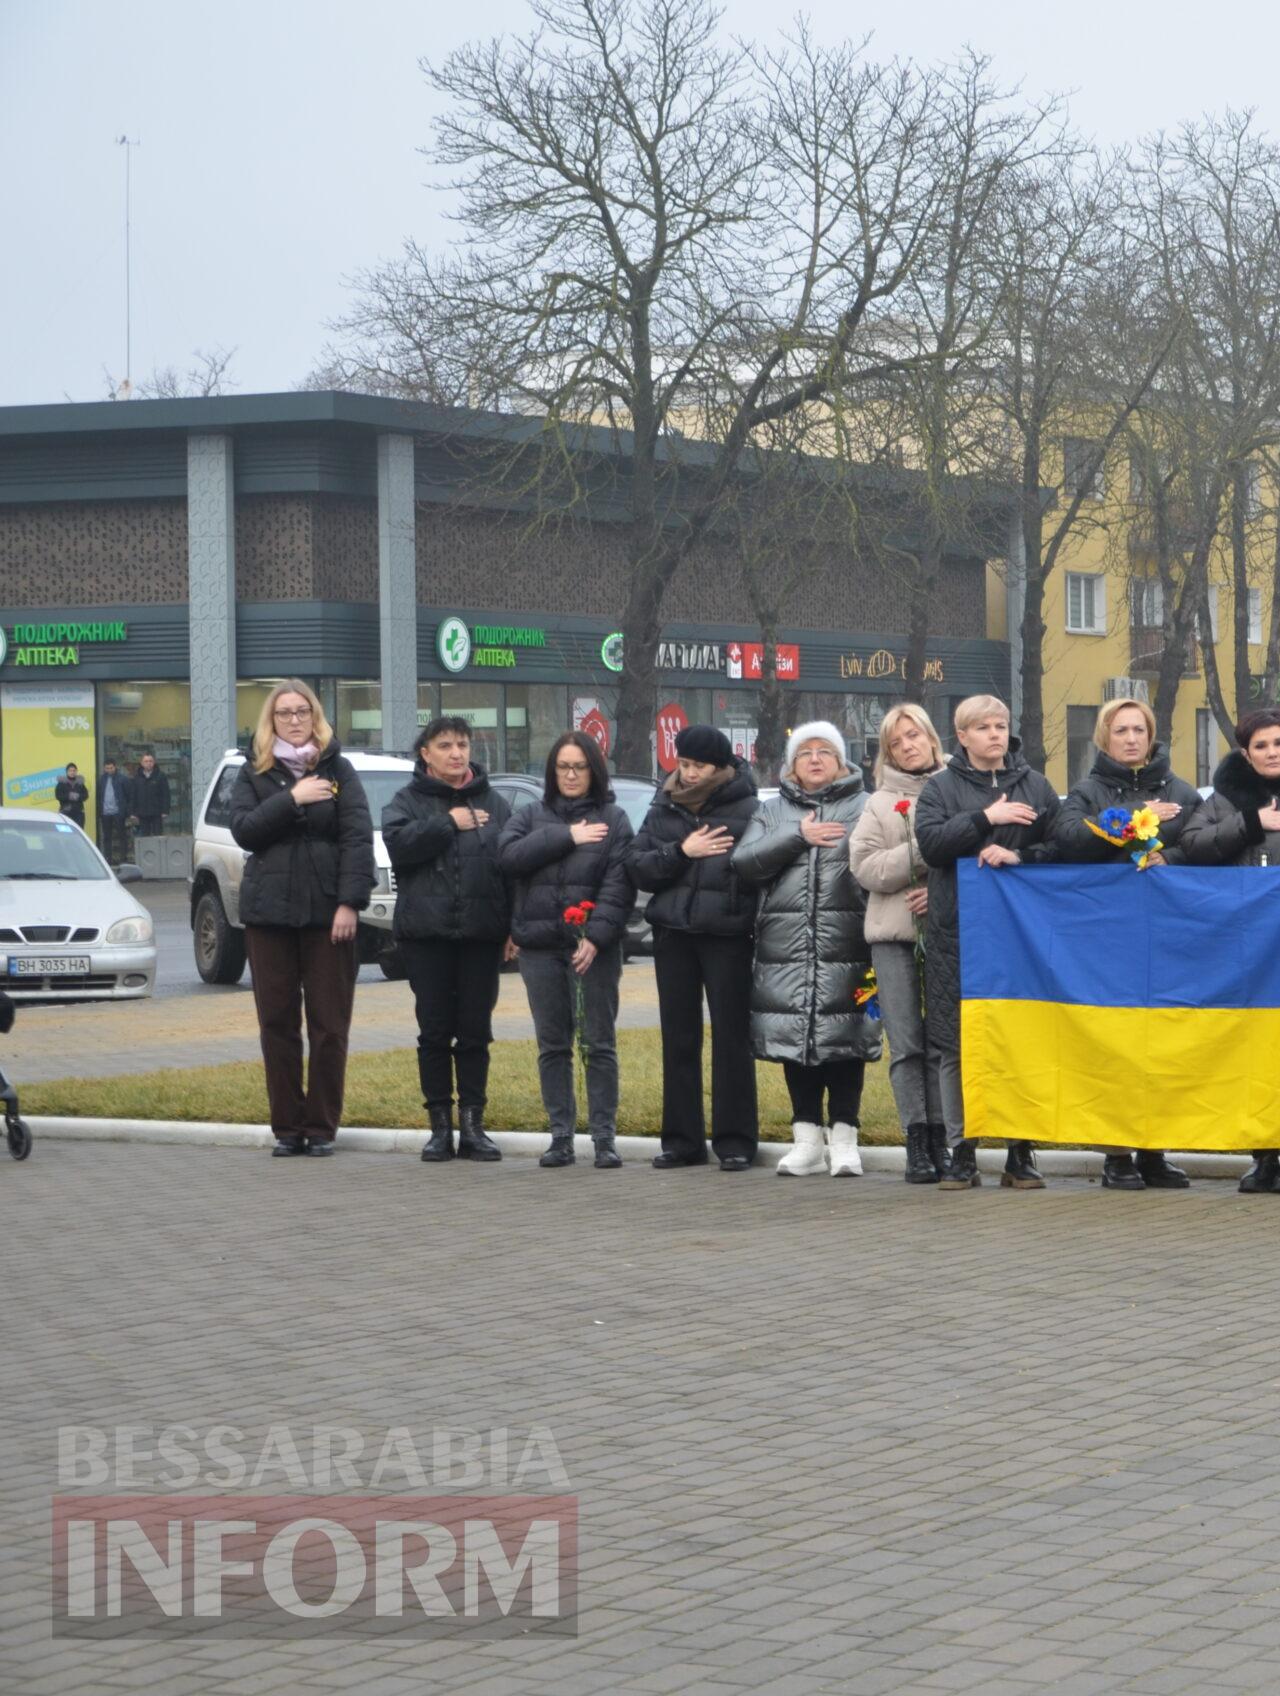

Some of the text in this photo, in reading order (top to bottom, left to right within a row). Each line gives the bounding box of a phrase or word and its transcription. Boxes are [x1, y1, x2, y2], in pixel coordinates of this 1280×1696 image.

[14, 621, 127, 644] ПОДОРОЖНИК
[474, 625, 546, 647] ПОДОРОЖНИК
[15, 646, 79, 666] АПТЕКА
[472, 647, 516, 668] АПТЕКА
[55, 715, 90, 731] -30%
[18, 960, 87, 972] BH 3035 HA
